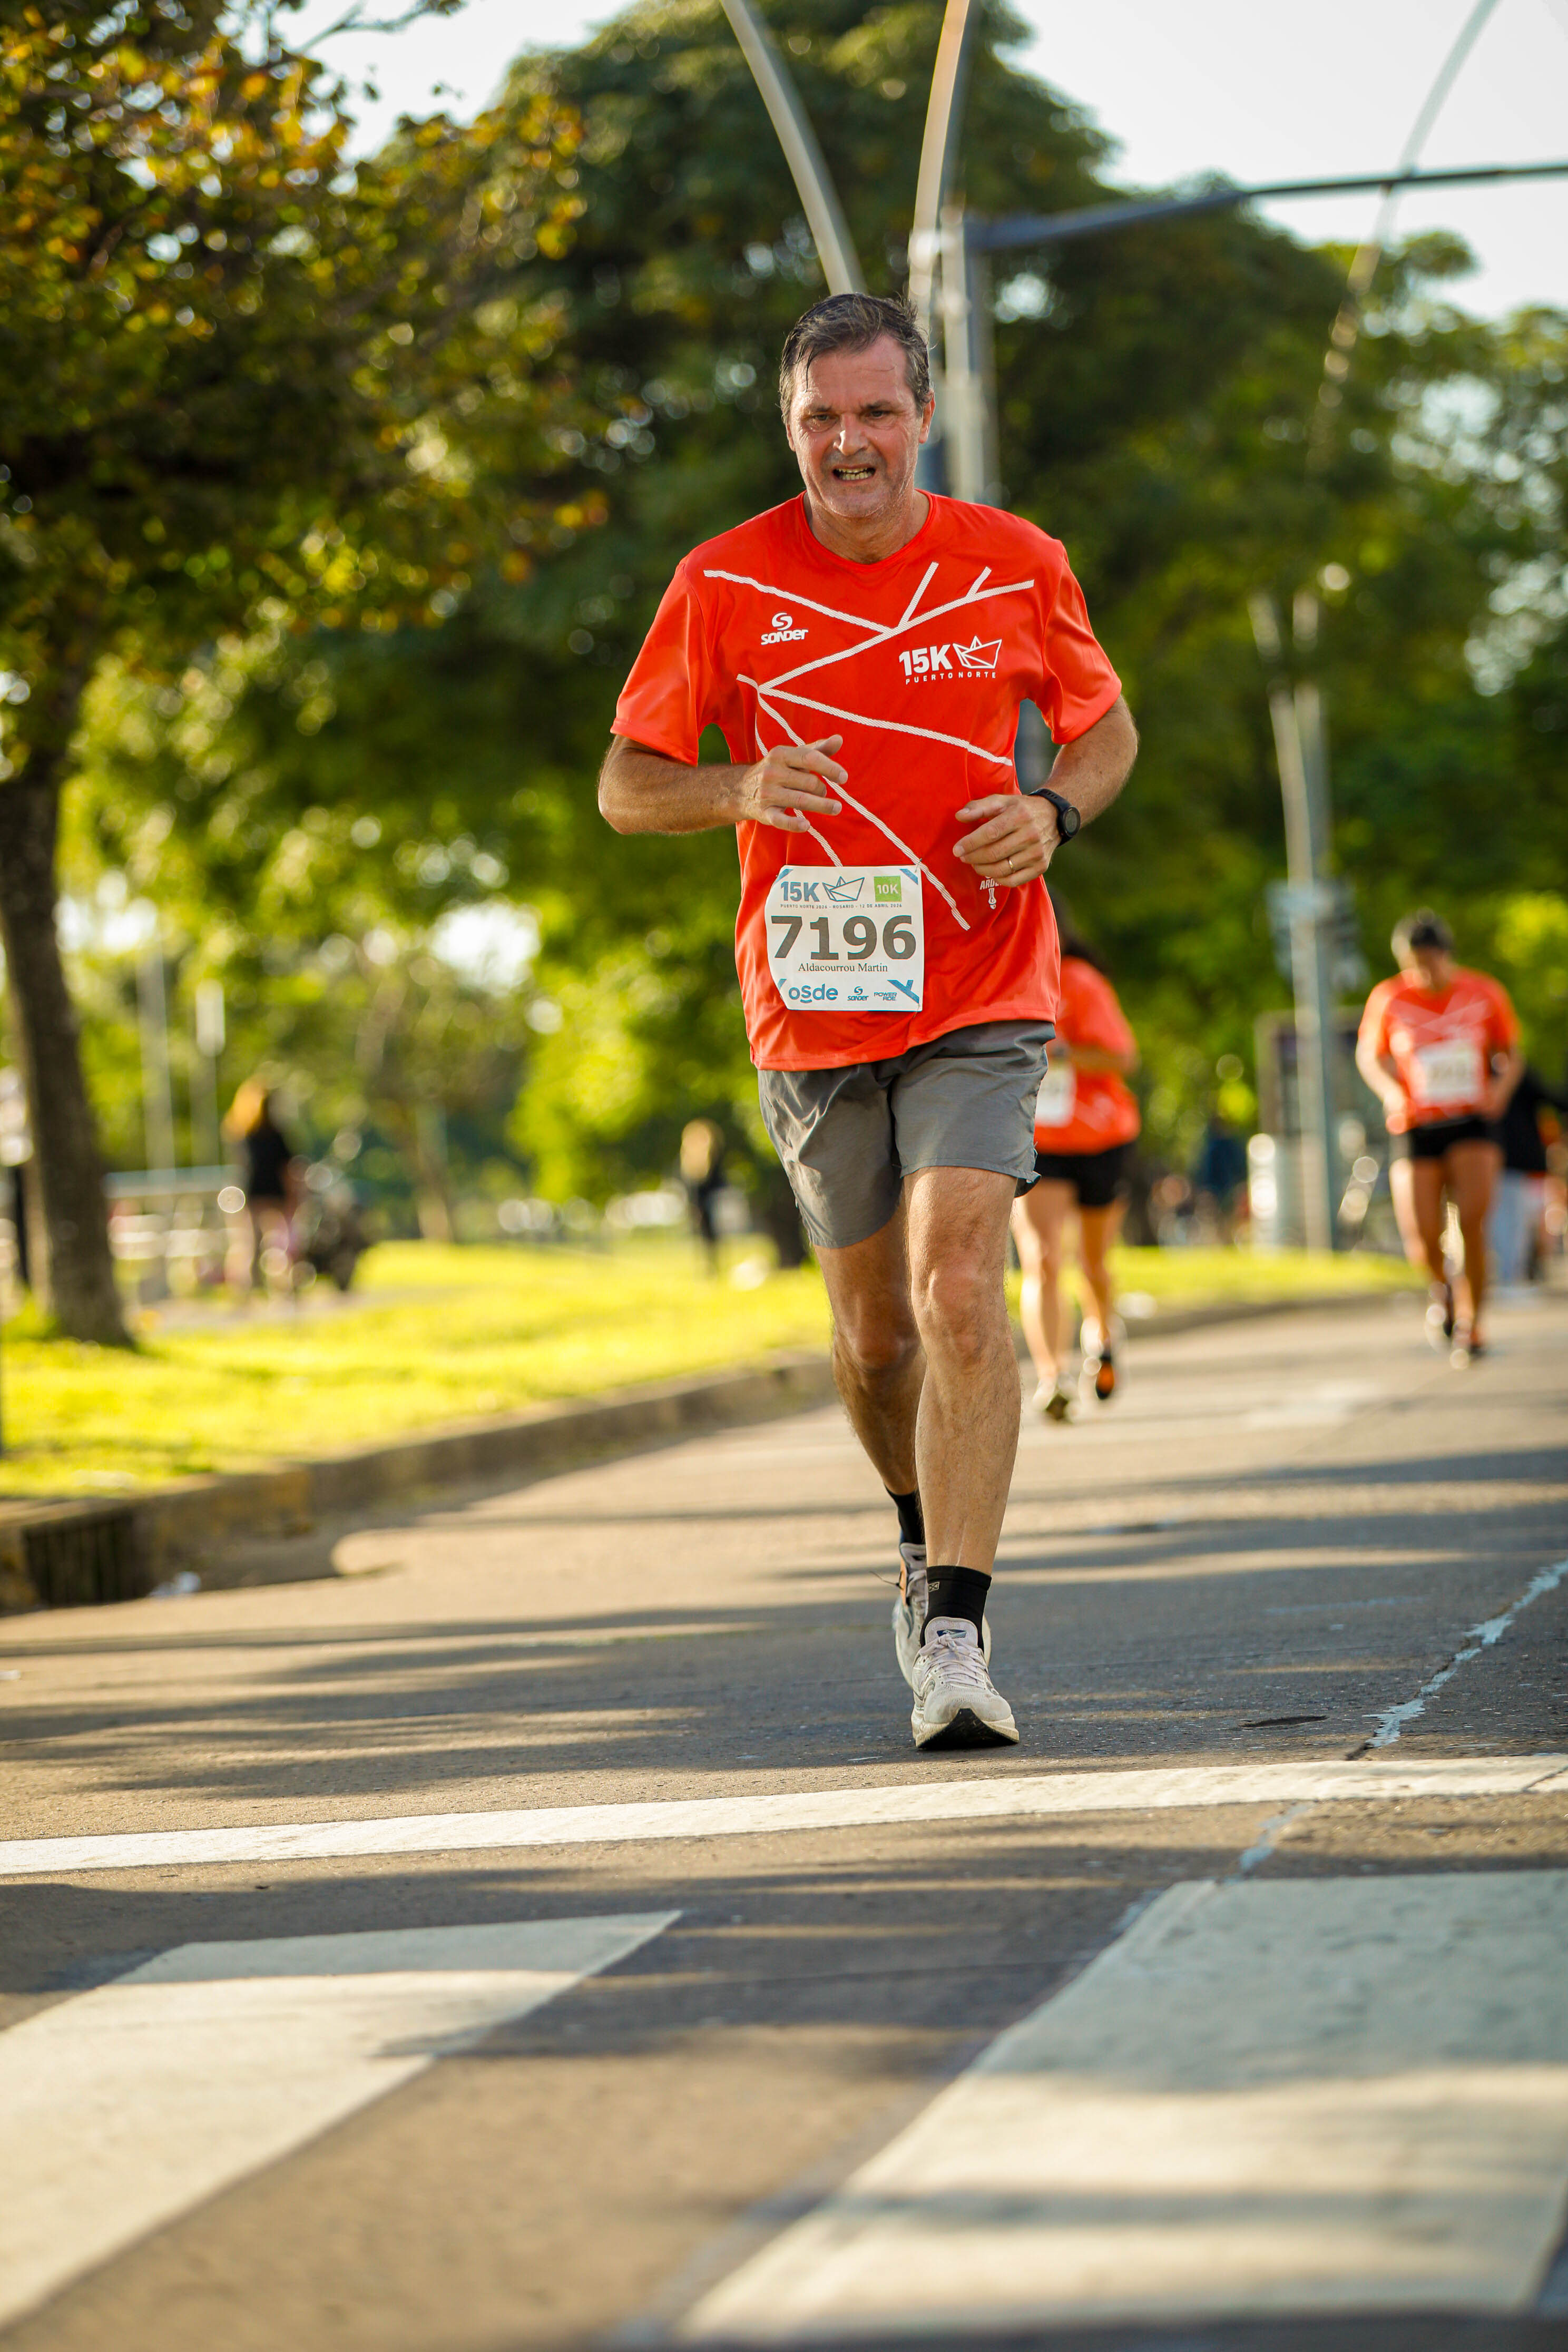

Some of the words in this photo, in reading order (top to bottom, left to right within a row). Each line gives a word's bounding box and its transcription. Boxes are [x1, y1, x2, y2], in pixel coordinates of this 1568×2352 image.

[899, 644, 953, 676] 15K
[906, 672, 953, 685] PUERTO
[780, 881, 820, 902] 15K
[877, 884, 899, 894] 10K
[771, 915, 916, 960] 7196
[798, 963, 855, 972] Aldacourrou
[858, 963, 888, 972] Martin
